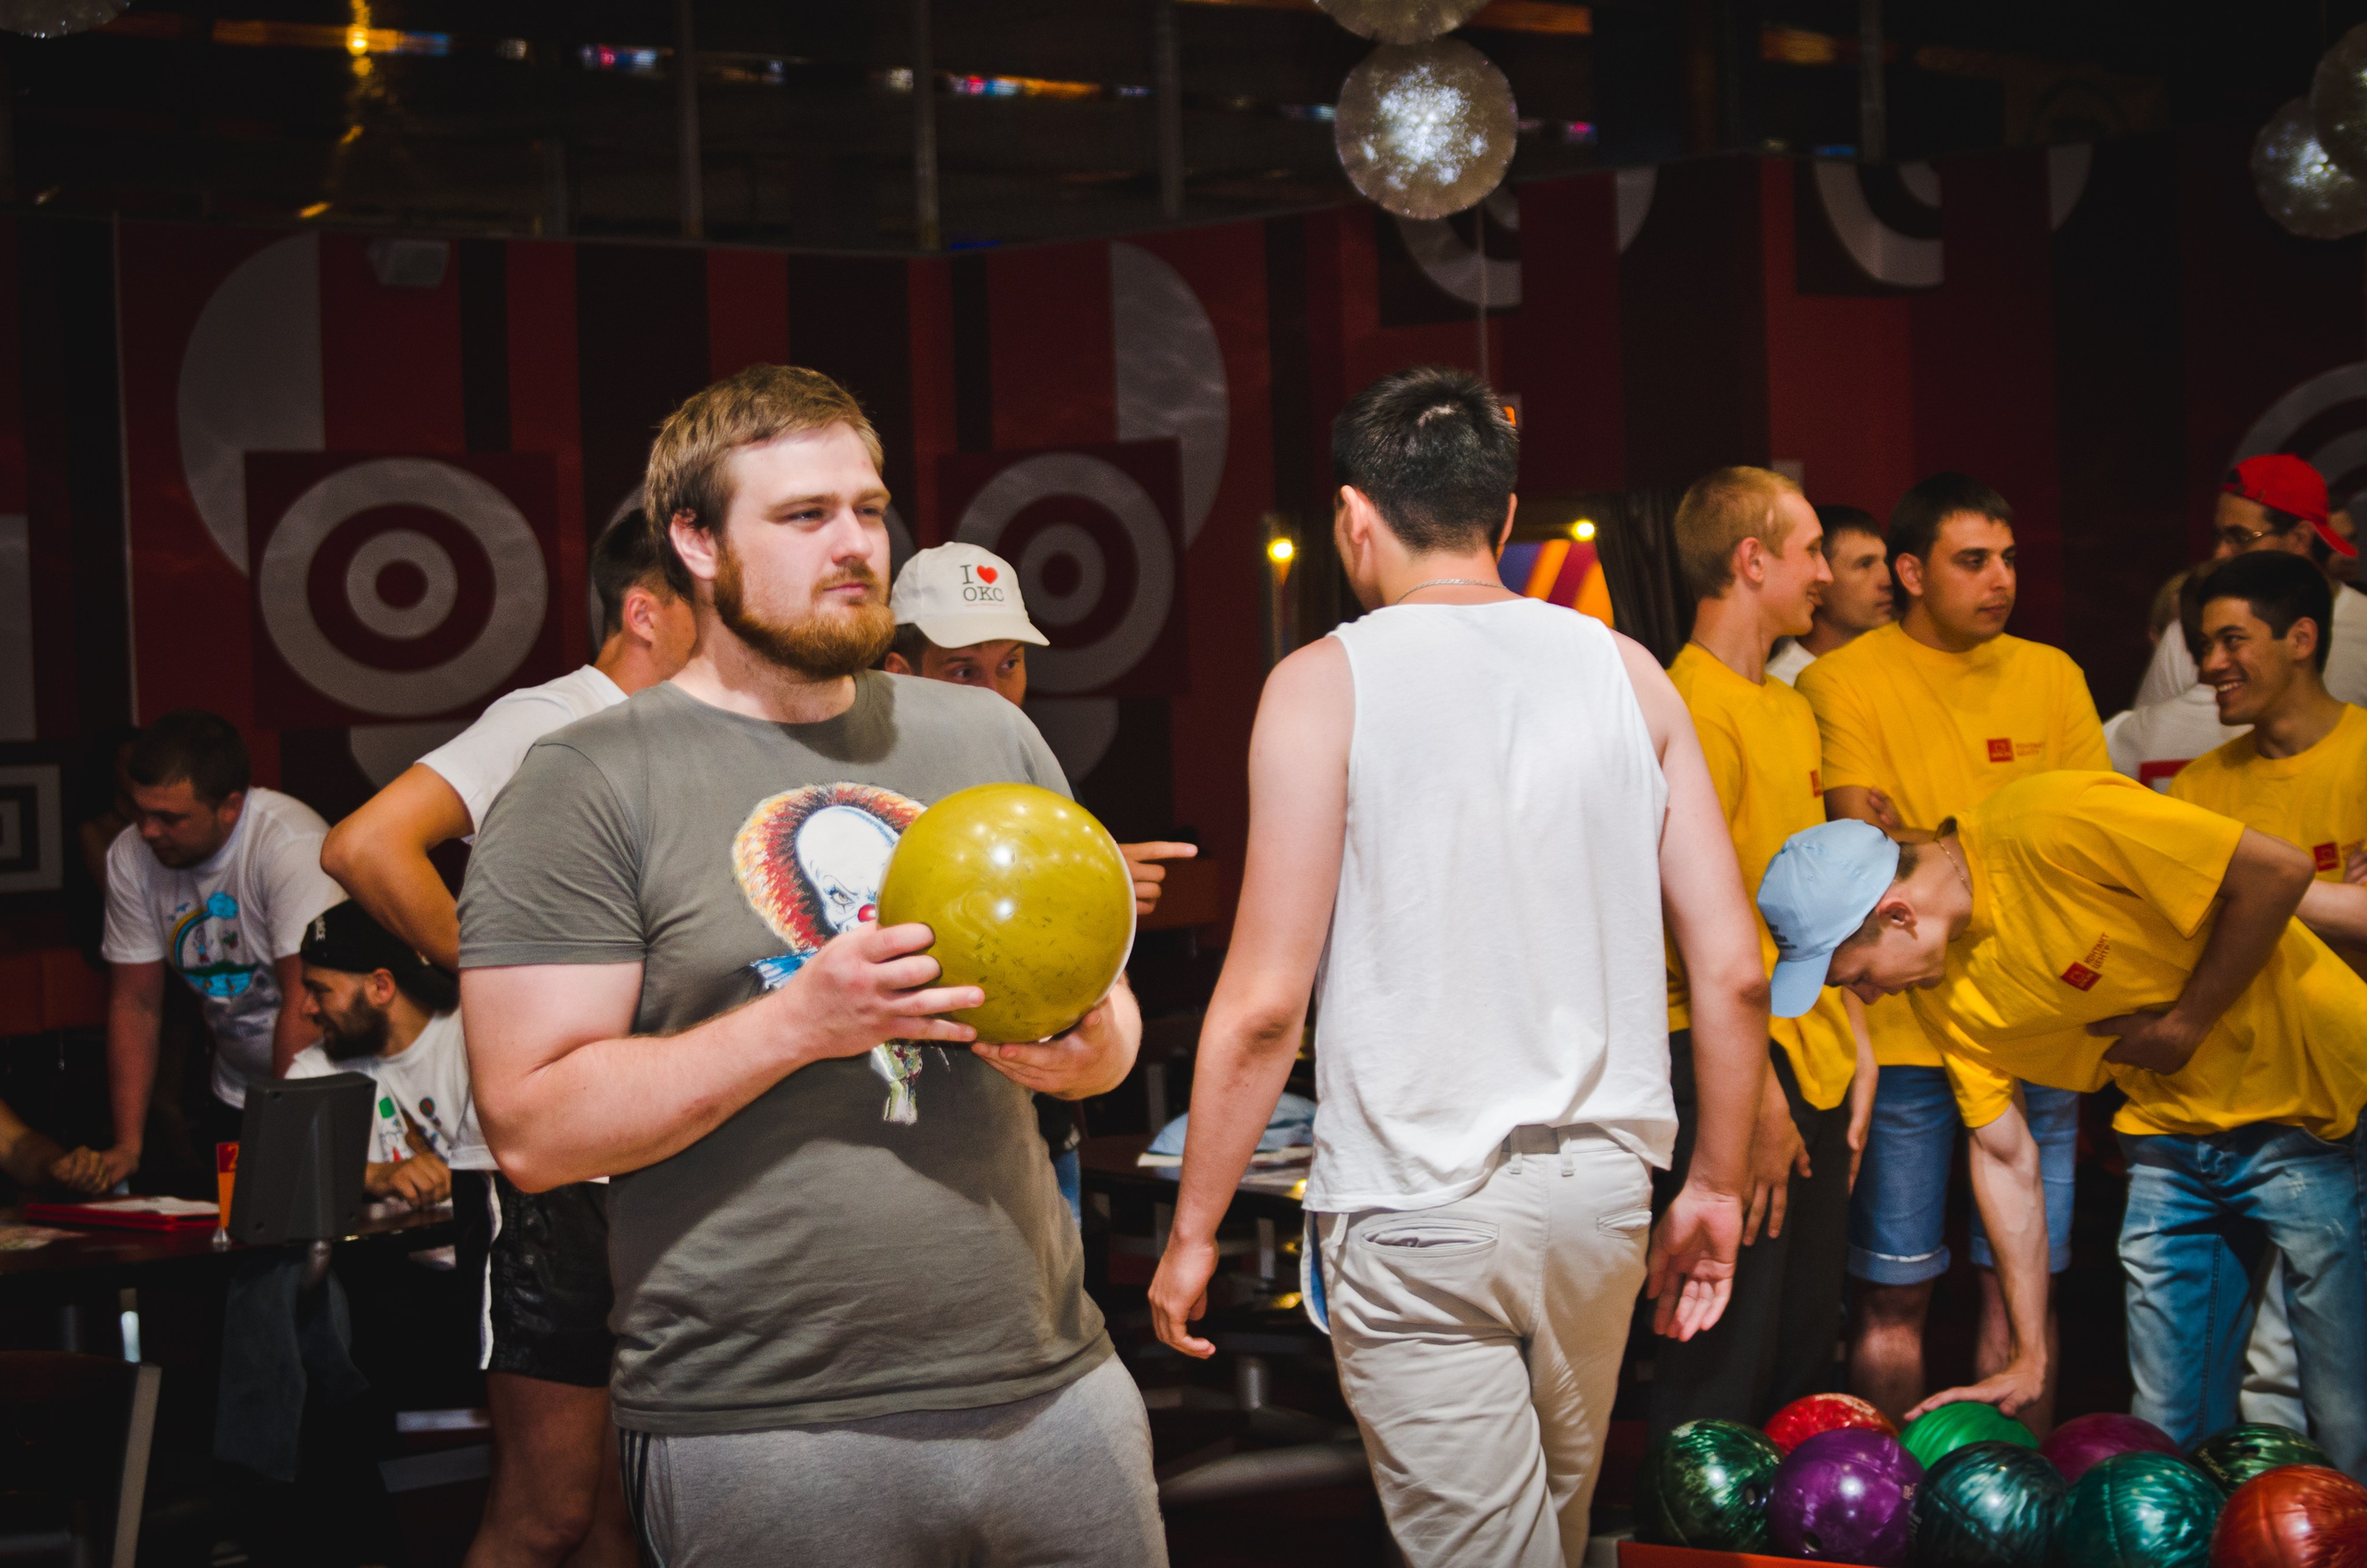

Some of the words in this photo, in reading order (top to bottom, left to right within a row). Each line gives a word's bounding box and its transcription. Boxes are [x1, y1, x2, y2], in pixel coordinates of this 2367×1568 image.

[960, 564, 974, 584] I
[963, 586, 1004, 602] OKC
[2083, 932, 2109, 963] КОНТАКТ
[2092, 945, 2110, 969] ЦЕНТР
